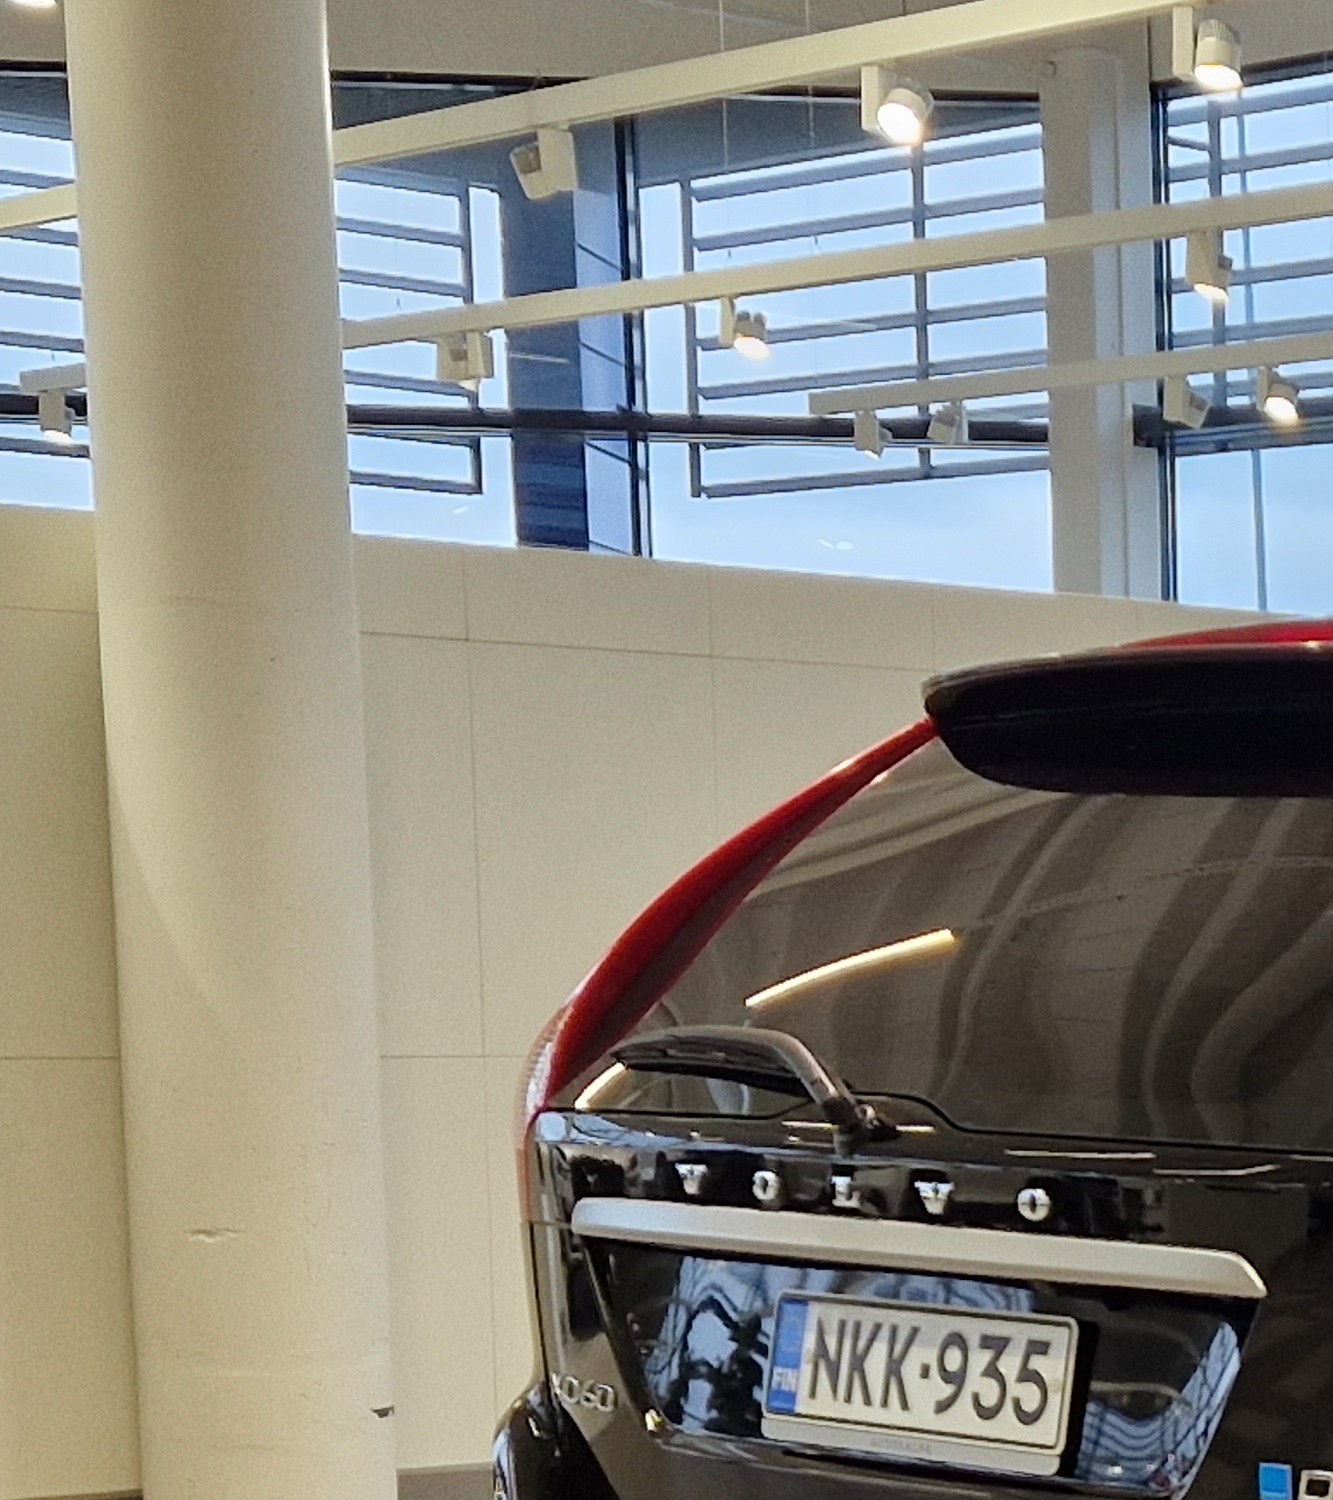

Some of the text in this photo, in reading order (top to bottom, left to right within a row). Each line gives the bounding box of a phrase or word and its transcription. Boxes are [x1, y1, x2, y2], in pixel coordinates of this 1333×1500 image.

[674, 1163, 1051, 1222] VOLVO
[772, 1367, 798, 1392] FIN
[809, 1316, 1051, 1426] NKK-935
